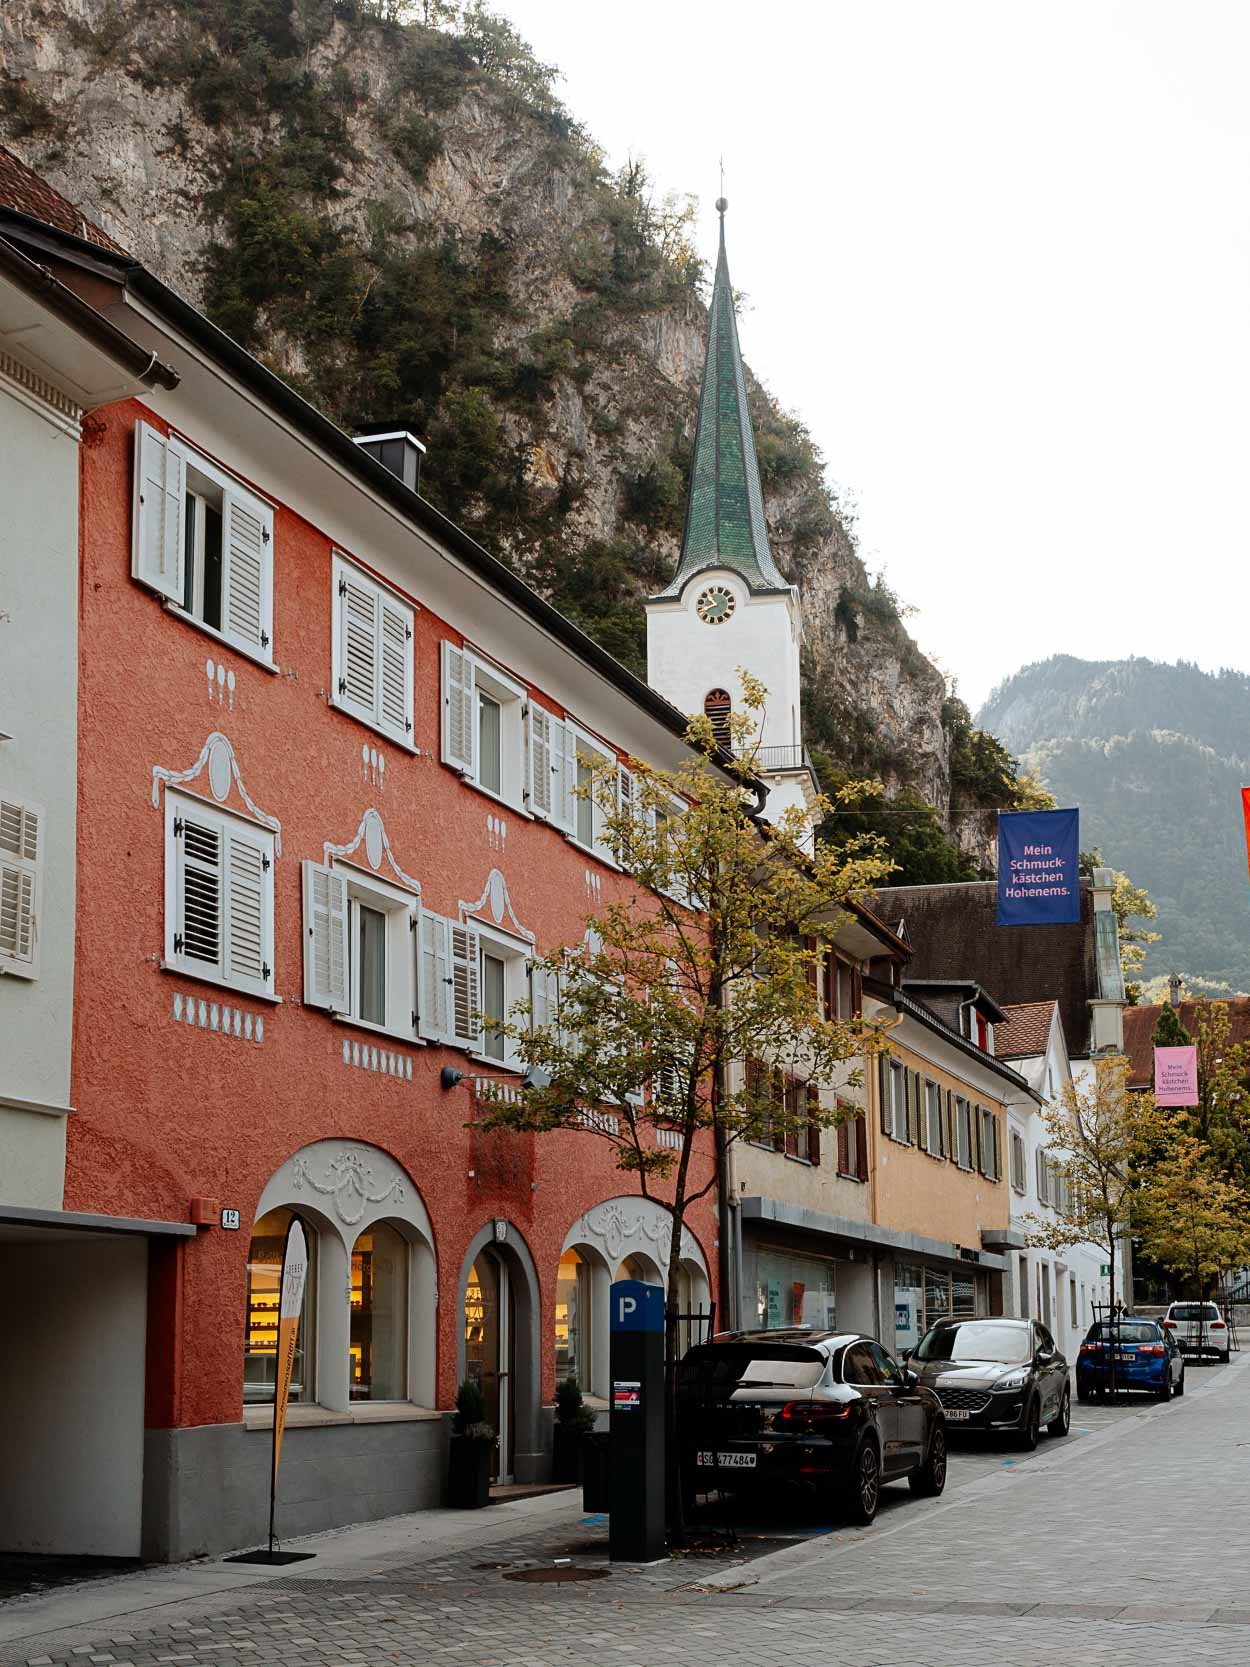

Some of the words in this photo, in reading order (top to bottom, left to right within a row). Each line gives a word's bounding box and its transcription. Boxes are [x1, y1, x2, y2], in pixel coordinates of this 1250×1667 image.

[1024, 844, 1052, 856] Mein
[1010, 857, 1066, 870] Schmuck-
[1012, 872, 1063, 884] kästchen
[1005, 887, 1070, 898] Hohenems.
[226, 1210, 236, 1223] 12
[619, 1297, 636, 1322] P
